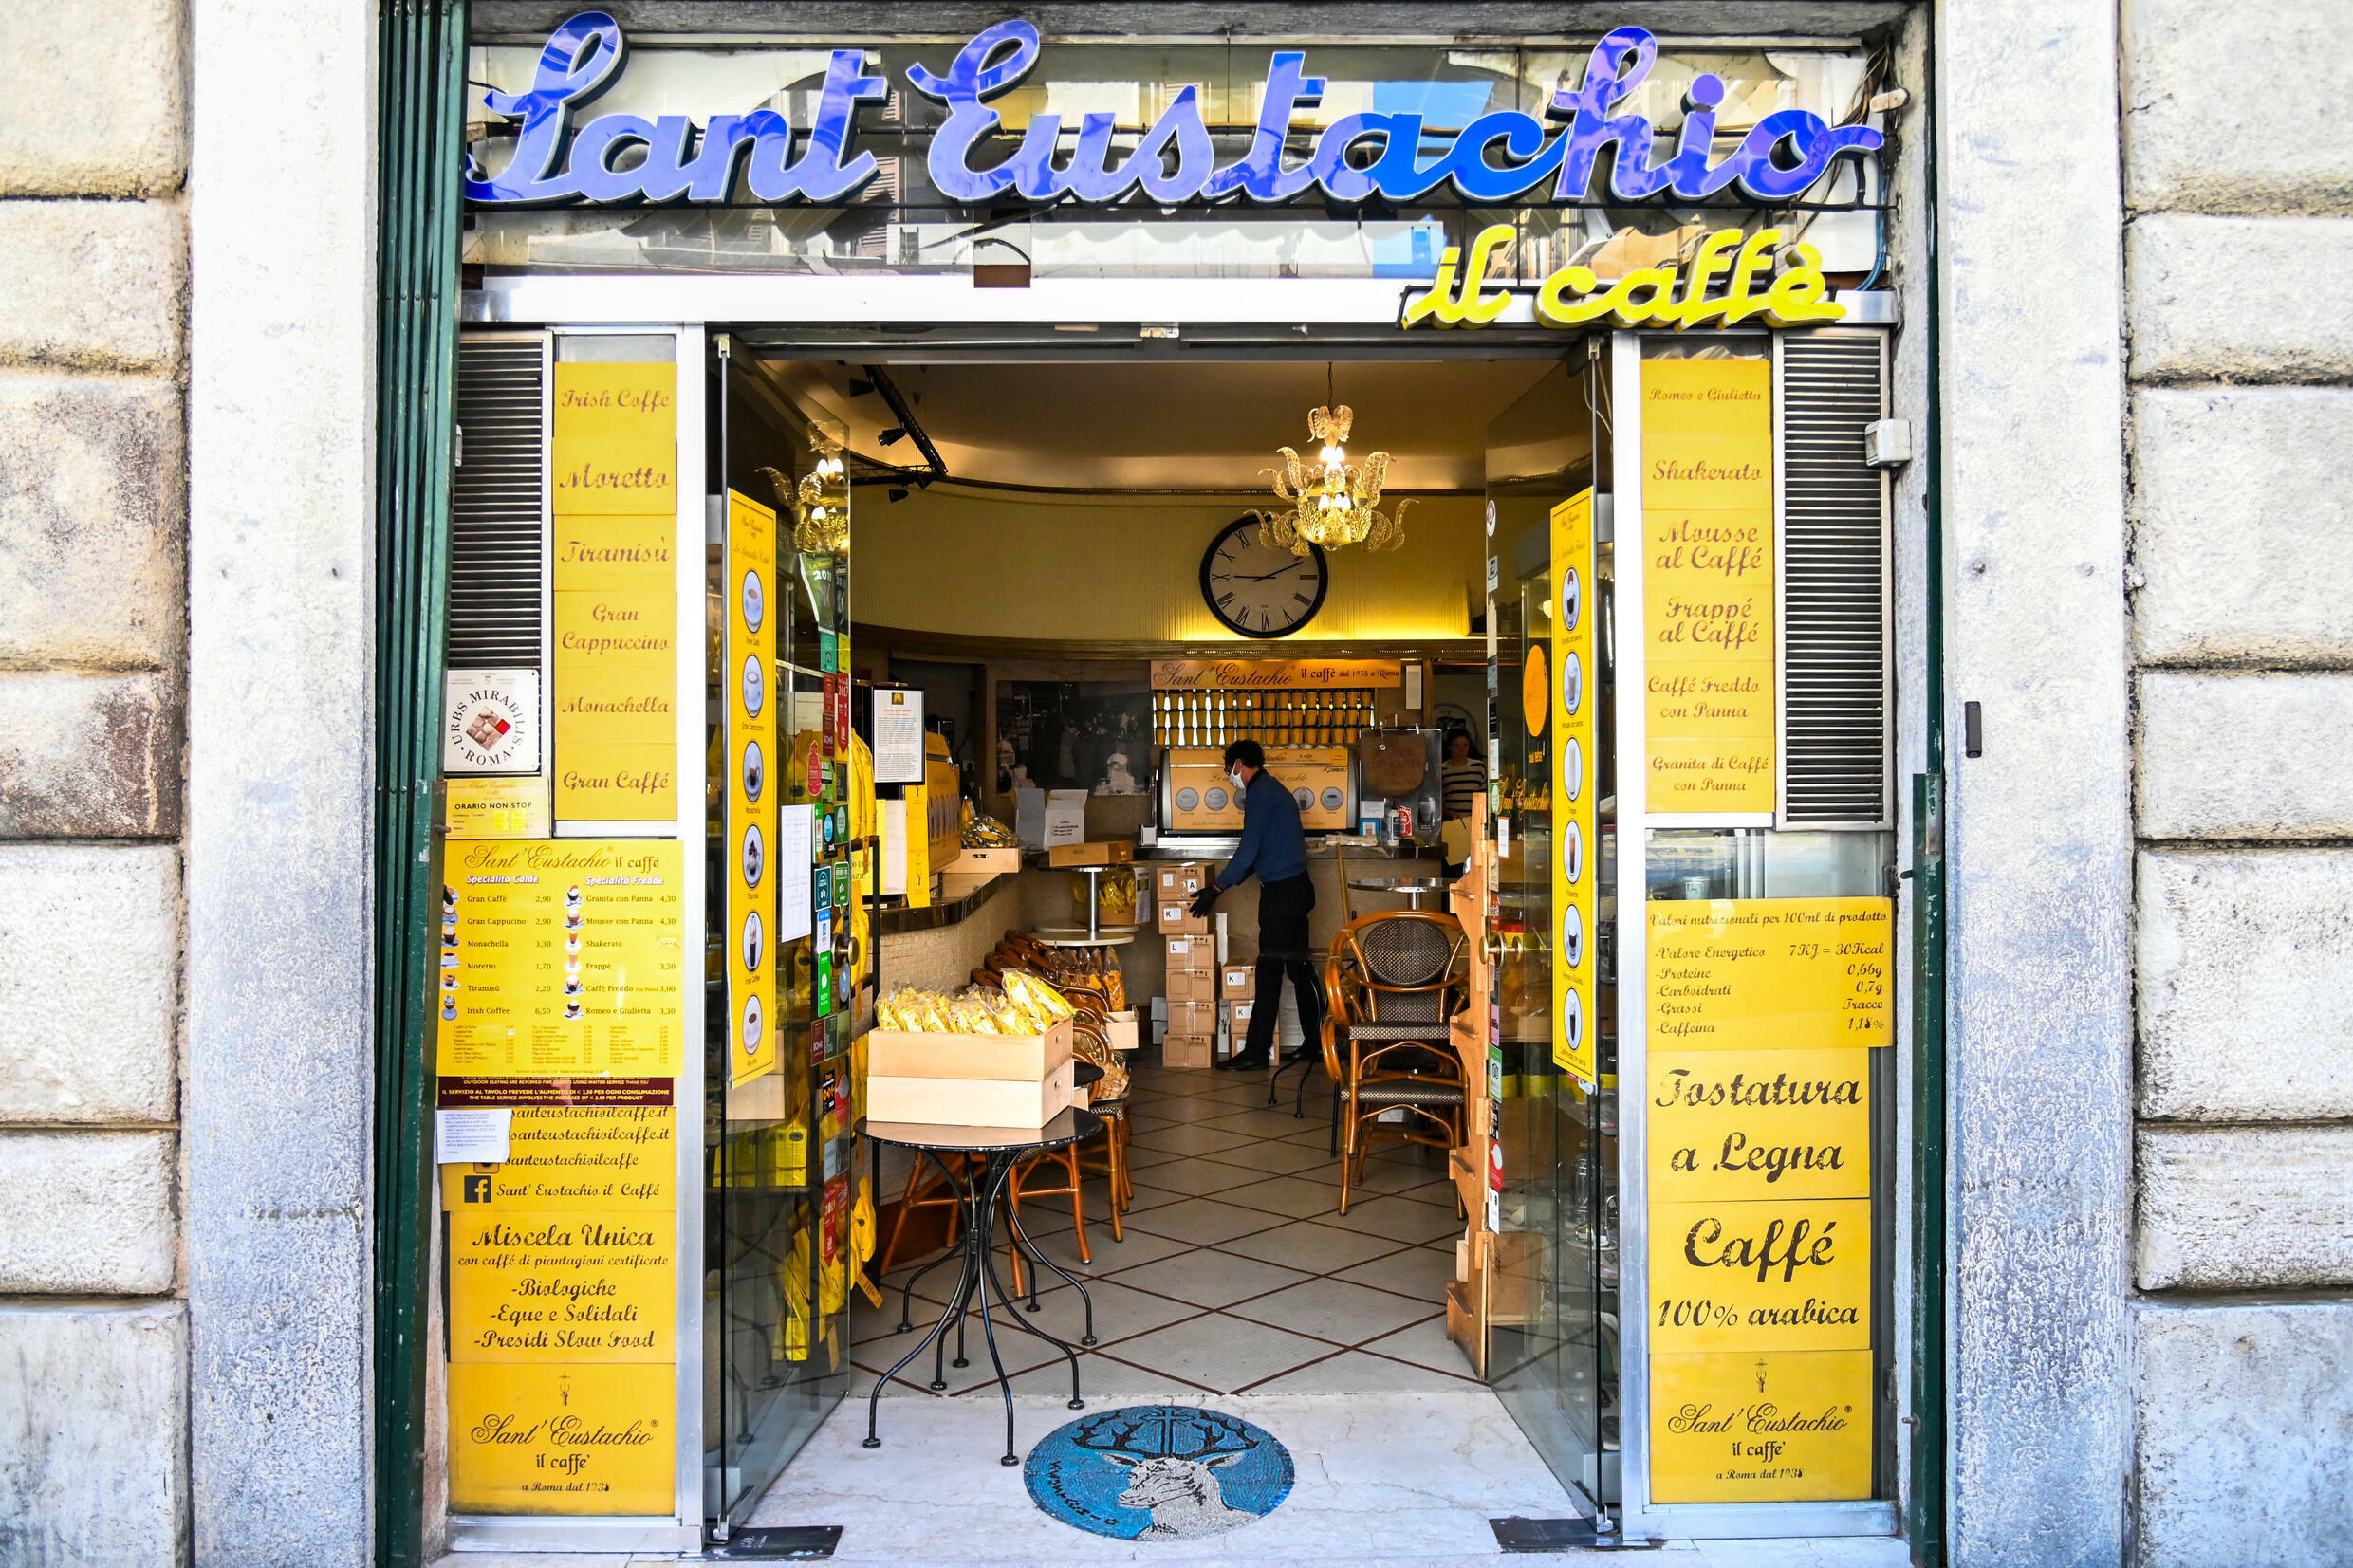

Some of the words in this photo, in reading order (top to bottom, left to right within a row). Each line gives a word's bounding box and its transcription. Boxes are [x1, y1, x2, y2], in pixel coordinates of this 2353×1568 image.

[905, 17, 1882, 207] Eustachio
[1405, 226, 1511, 327] il
[1529, 226, 1848, 332] caffè
[561, 389, 612, 408] Irish
[1649, 388, 1694, 401] Romeo
[1707, 388, 1762, 402] Giulietta
[1653, 460, 1763, 481] Shakerato
[1659, 519, 1759, 542] Mousse
[561, 535, 670, 563] Tiramisù
[1656, 546, 1684, 569] al
[592, 603, 639, 622] Gran
[1658, 621, 1685, 643] al
[562, 631, 670, 655] Cappuccino
[1215, 663, 1293, 687] Eustachio
[1301, 669, 1308, 678] il
[1378, 669, 1400, 678] Roma
[1700, 676, 1761, 692] Freddo
[562, 696, 670, 714] Monachella
[1660, 708, 1687, 718] con
[1693, 702, 1749, 718] Panna
[451, 702, 468, 746] URBS
[468, 689, 525, 747] MIRABILIS
[464, 748, 512, 766] ROMA
[1652, 756, 1706, 771] Granita
[1711, 756, 1724, 770] di
[563, 770, 610, 793] Gran
[1673, 782, 1693, 791] con
[1700, 777, 1747, 791] Panna
[528, 844, 612, 870] Eustachio
[615, 856, 623, 868] il
[513, 875, 539, 884] Calde
[535, 895, 552, 904] 2,90
[1165, 910, 1172, 918] K
[1762, 916, 1781, 931] per
[1824, 911, 1836, 924] di
[1838, 911, 1887, 926] prodotto
[1704, 945, 1766, 961] Energetico
[534, 1007, 551, 1016] 6,50
[1843, 998, 1883, 1010] Tracce
[1655, 1068, 1863, 1108] Tostatura
[1670, 1148, 1699, 1172] a
[1712, 1132, 1845, 1184] Legna
[535, 1183, 600, 1196] Eustachio
[602, 1183, 613, 1196] il
[472, 1223, 573, 1247] Miscela
[581, 1224, 655, 1246] Unica
[1684, 1217, 1838, 1283] Caffé
[457, 1256, 479, 1265] con
[518, 1254, 530, 1265] di
[534, 1254, 605, 1269] piantagioni
[607, 1254, 669, 1268] certificate
[548, 1311, 559, 1321] e
[564, 1304, 639, 1322] Solidali
[1658, 1299, 1739, 1329] 100%
[1748, 1298, 1861, 1326] arabica
[553, 1330, 602, 1348] Slow
[607, 1330, 655, 1348] Food
[1746, 1402, 1848, 1435] Eustachio
[550, 1414, 654, 1448] Eustachio
[1732, 1442, 1742, 1457] il
[536, 1453, 546, 1468] il
[1725, 1469, 1756, 1480] Roma
[1759, 1469, 1777, 1480] dal
[530, 1482, 563, 1492] Roma
[565, 1482, 583, 1492] dal
